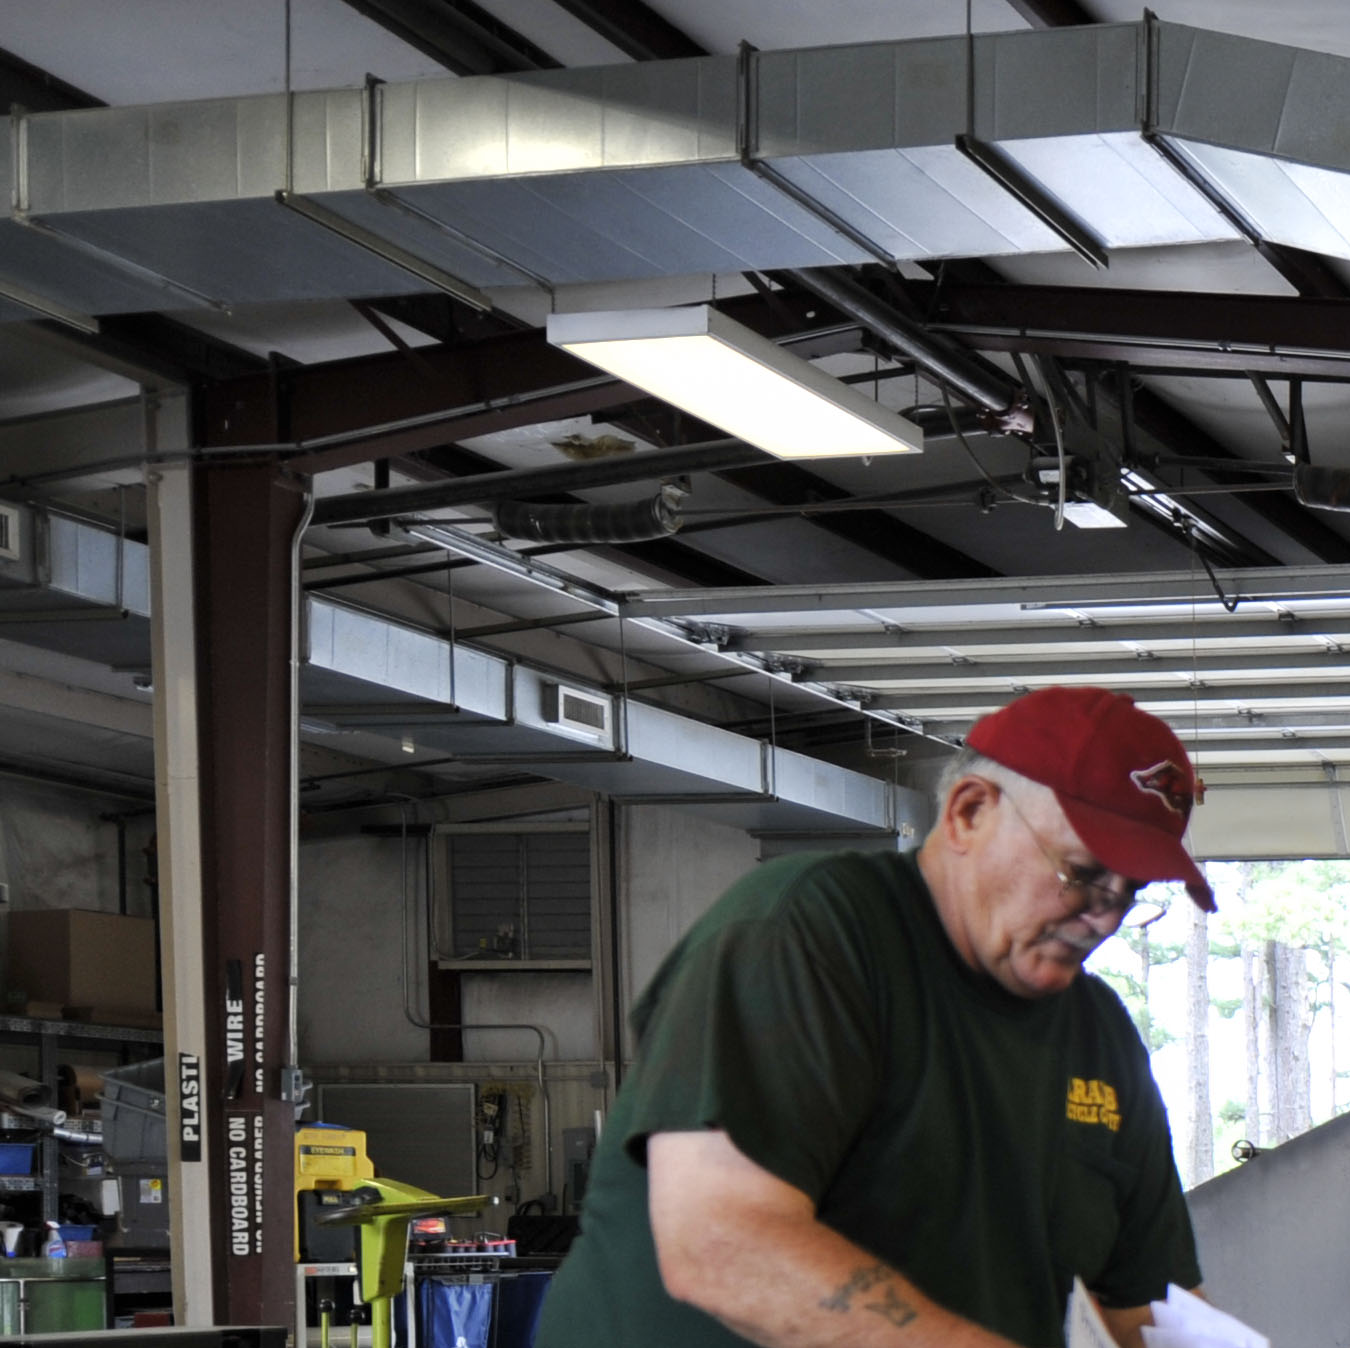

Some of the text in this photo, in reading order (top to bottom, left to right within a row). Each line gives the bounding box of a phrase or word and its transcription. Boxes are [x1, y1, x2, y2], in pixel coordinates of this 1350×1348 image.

[226, 998, 244, 1063] WIRE
[229, 1117, 249, 1256] NO CARDBOARD
